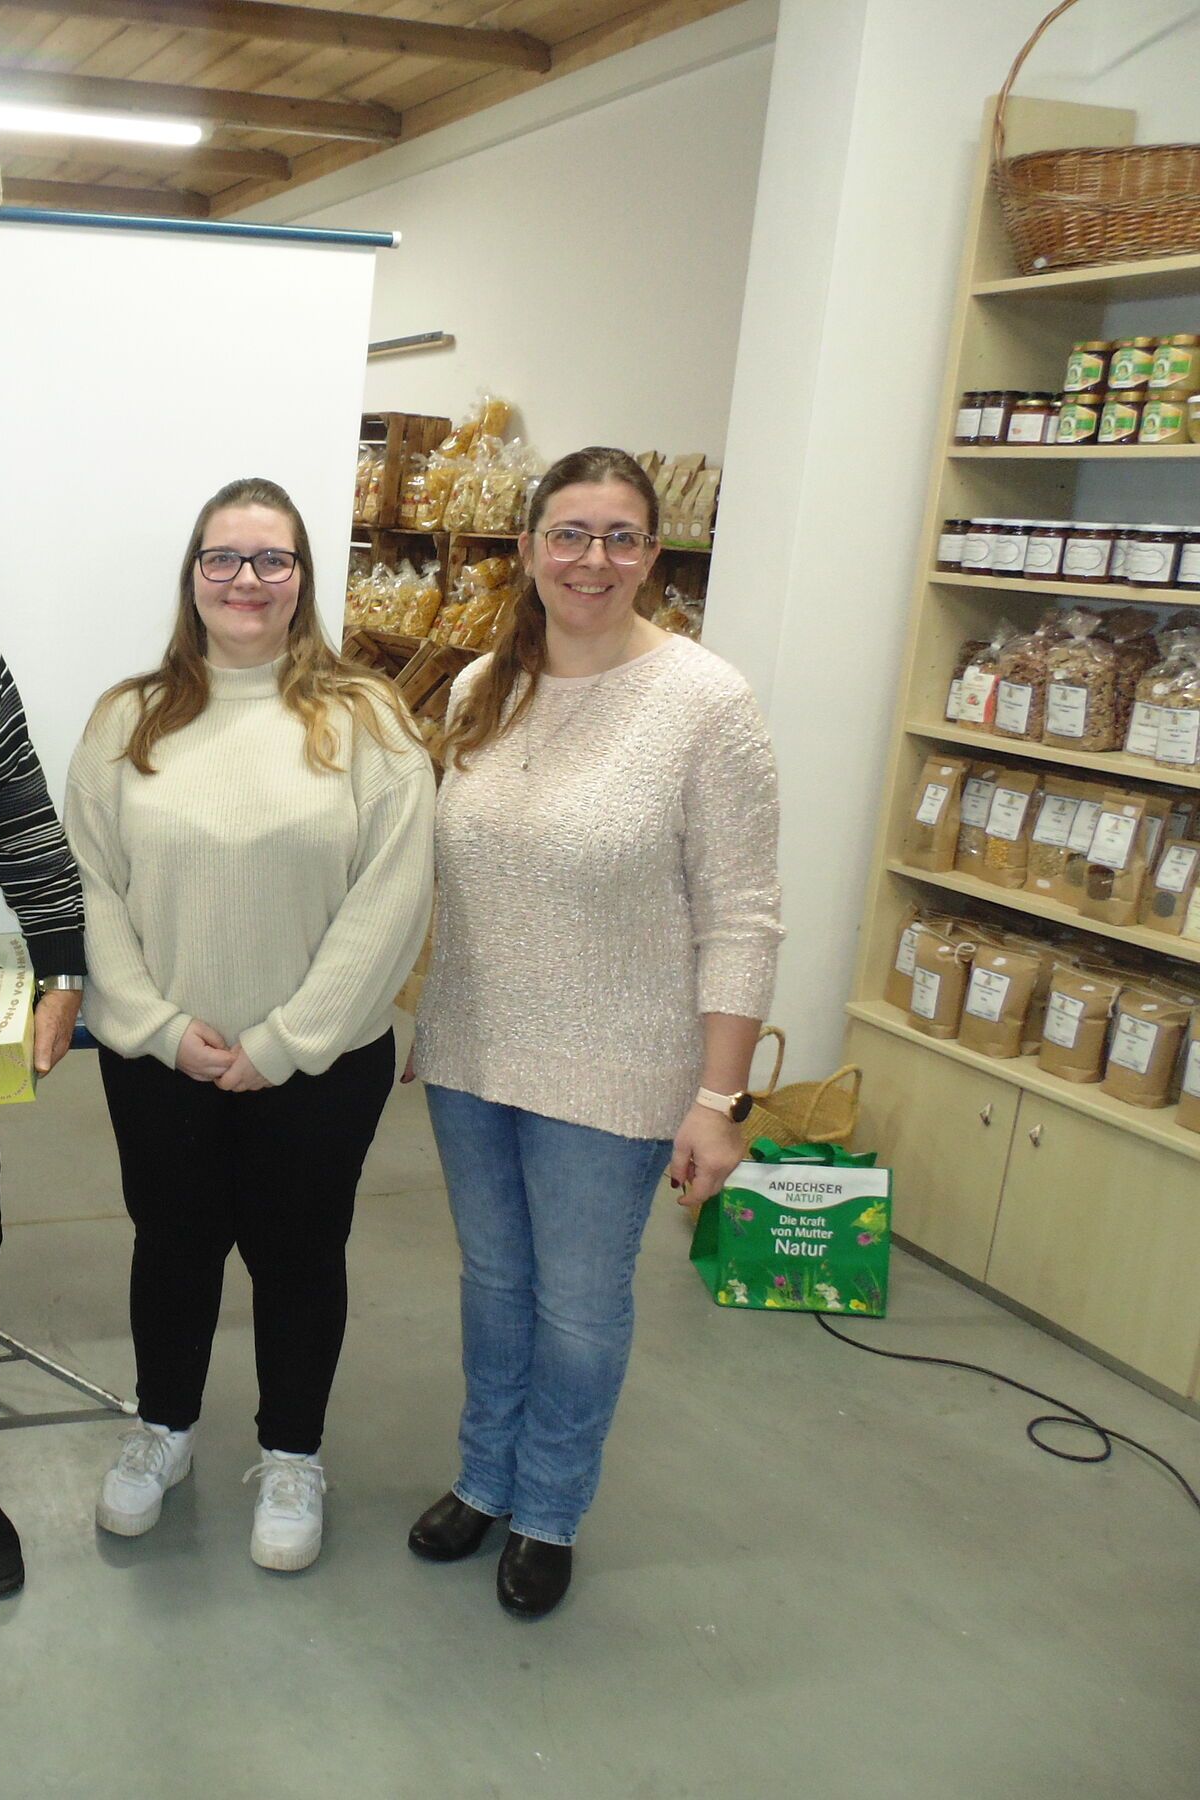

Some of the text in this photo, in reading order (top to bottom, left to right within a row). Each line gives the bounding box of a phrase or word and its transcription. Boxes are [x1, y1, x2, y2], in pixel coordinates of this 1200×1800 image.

[768, 1181, 843, 1195] ANDECHSER
[785, 1192, 824, 1203] NATUR
[779, 1214, 826, 1227] Die Kraft
[770, 1226, 834, 1239] von Mutter
[774, 1237, 828, 1257] Natur
